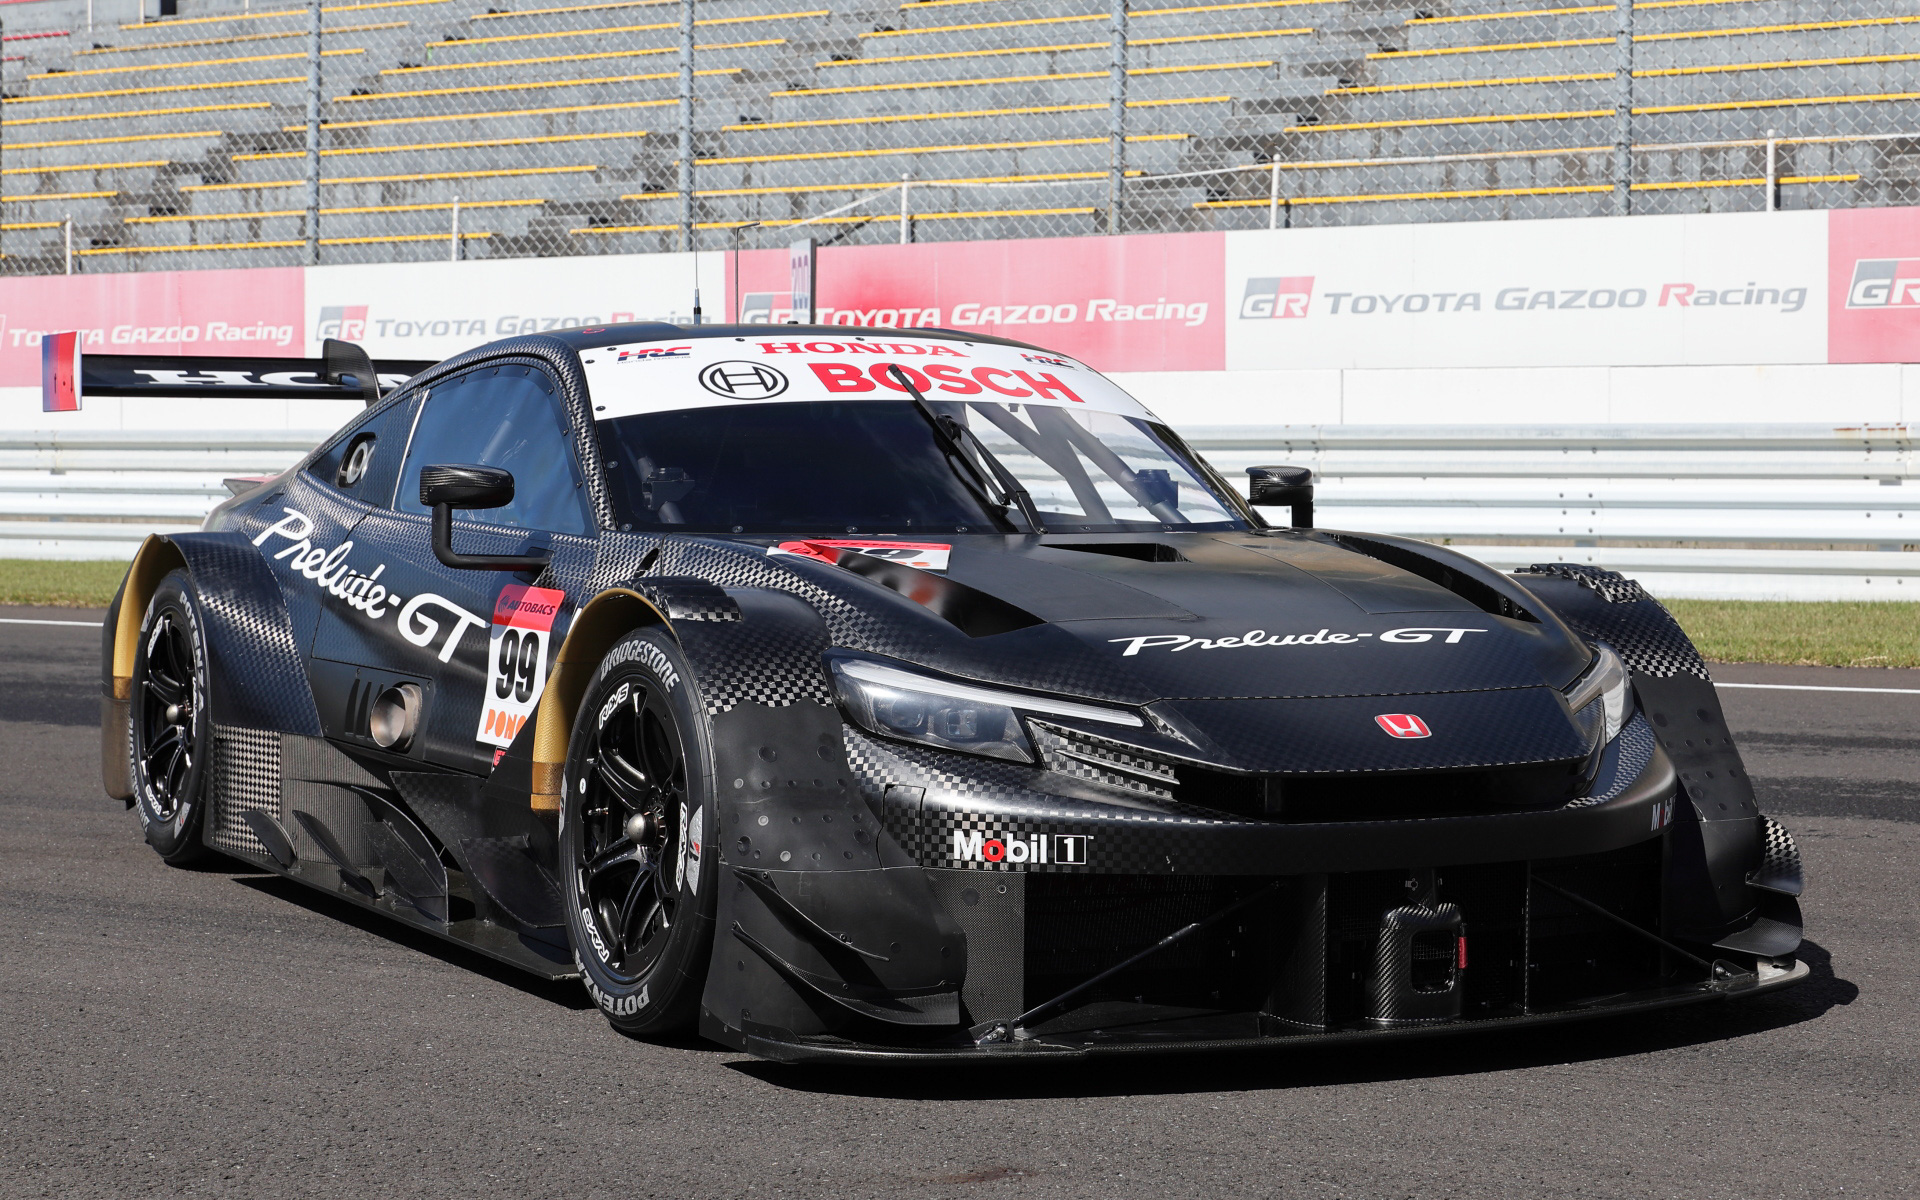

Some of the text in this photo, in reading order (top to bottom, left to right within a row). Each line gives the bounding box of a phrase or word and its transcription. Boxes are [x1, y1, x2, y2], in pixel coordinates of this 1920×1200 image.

[951, 303, 1078, 326] GAZOO
[1085, 298, 1208, 327] Racing
[1323, 292, 1480, 315] TOYOTA
[1494, 287, 1647, 311] GAZOO
[1658, 282, 1807, 313] Racing
[110, 325, 200, 344] GAZOO
[205, 321, 293, 346] Racing
[375, 317, 485, 338] TOYOTA
[617, 346, 692, 361] HRC
[755, 341, 971, 358] HONDA
[806, 362, 1086, 404] BOSCH
[252, 507, 491, 664] Prelude-GT
[507, 600, 556, 616] AUTOBACS
[1107, 627, 1489, 657] Prelude-GT
[495, 628, 540, 704] 99
[600, 639, 681, 693] BRIDGESTONE
[599, 682, 630, 730] RAYS
[953, 830, 1048, 864] Mobil
[582, 907, 610, 963] RAYS
